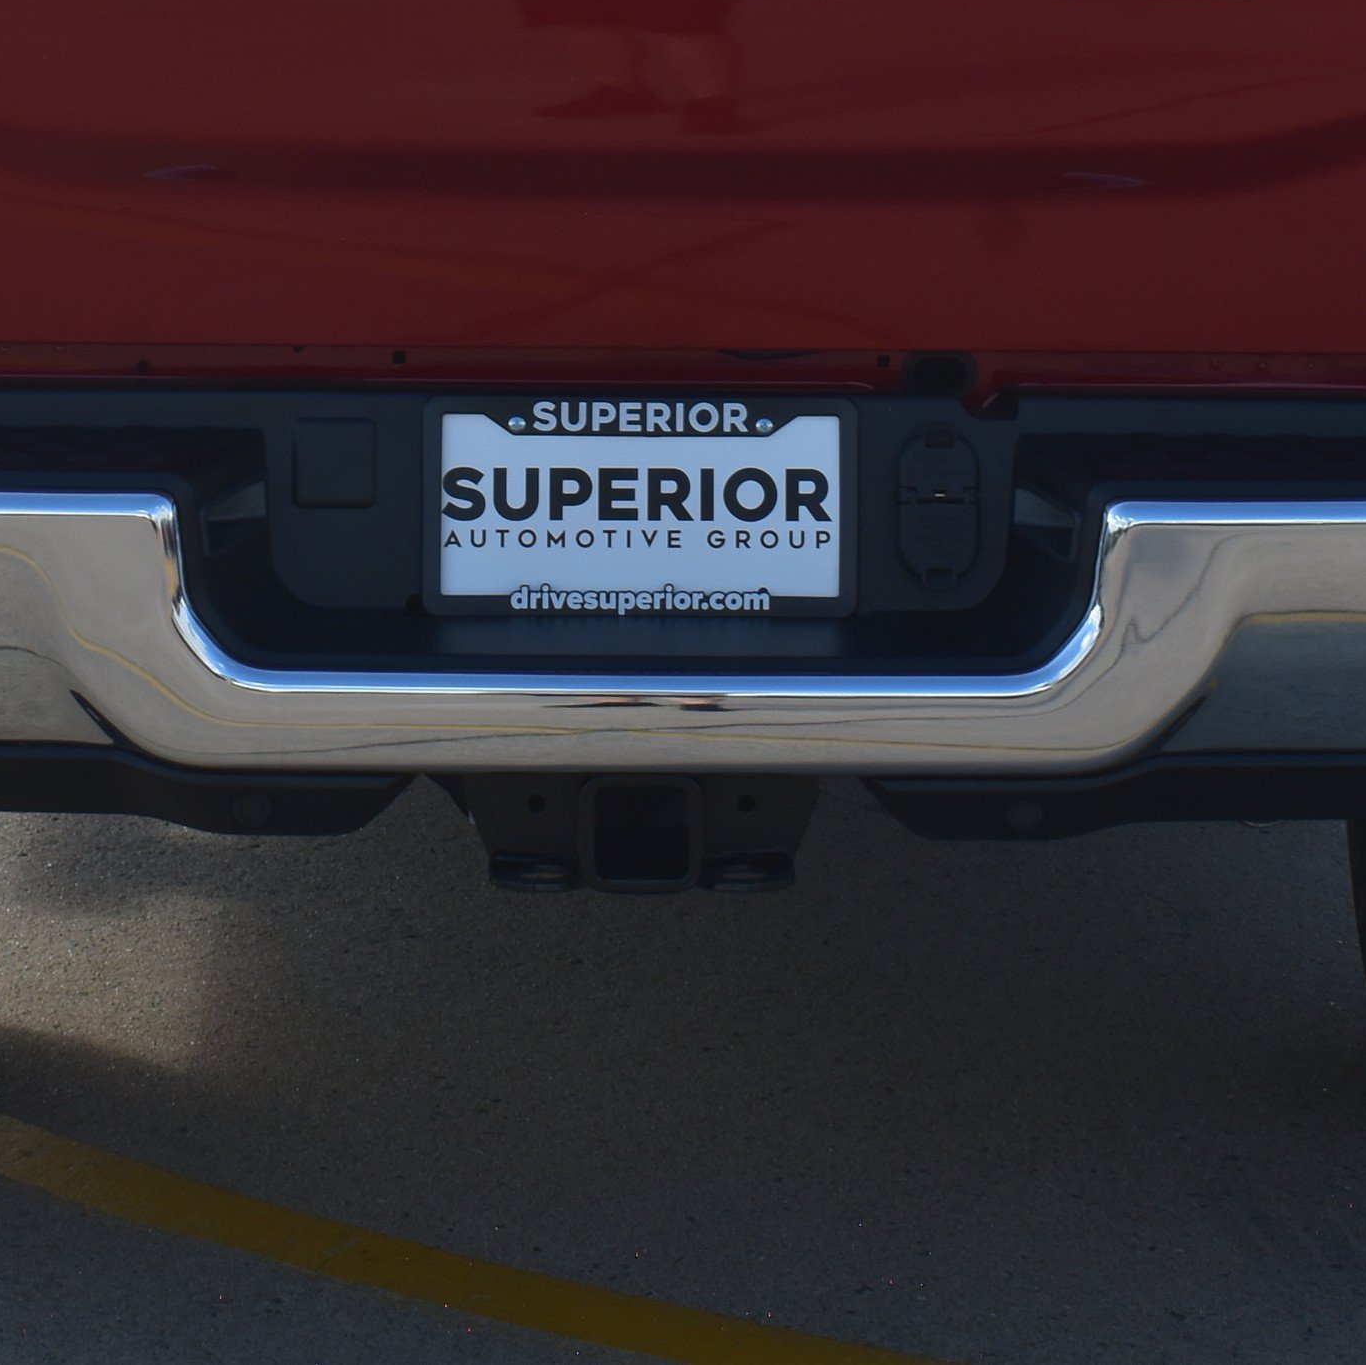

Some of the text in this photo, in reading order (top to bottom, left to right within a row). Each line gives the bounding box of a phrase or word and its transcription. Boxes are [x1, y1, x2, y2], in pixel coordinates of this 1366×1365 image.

[532, 401, 749, 433] SUPERIOR
[441, 466, 833, 523] SUPERIOR
[443, 528, 832, 550] AUTOMOTIVE GROUP
[510, 583, 771, 616] drivesuperior.com
